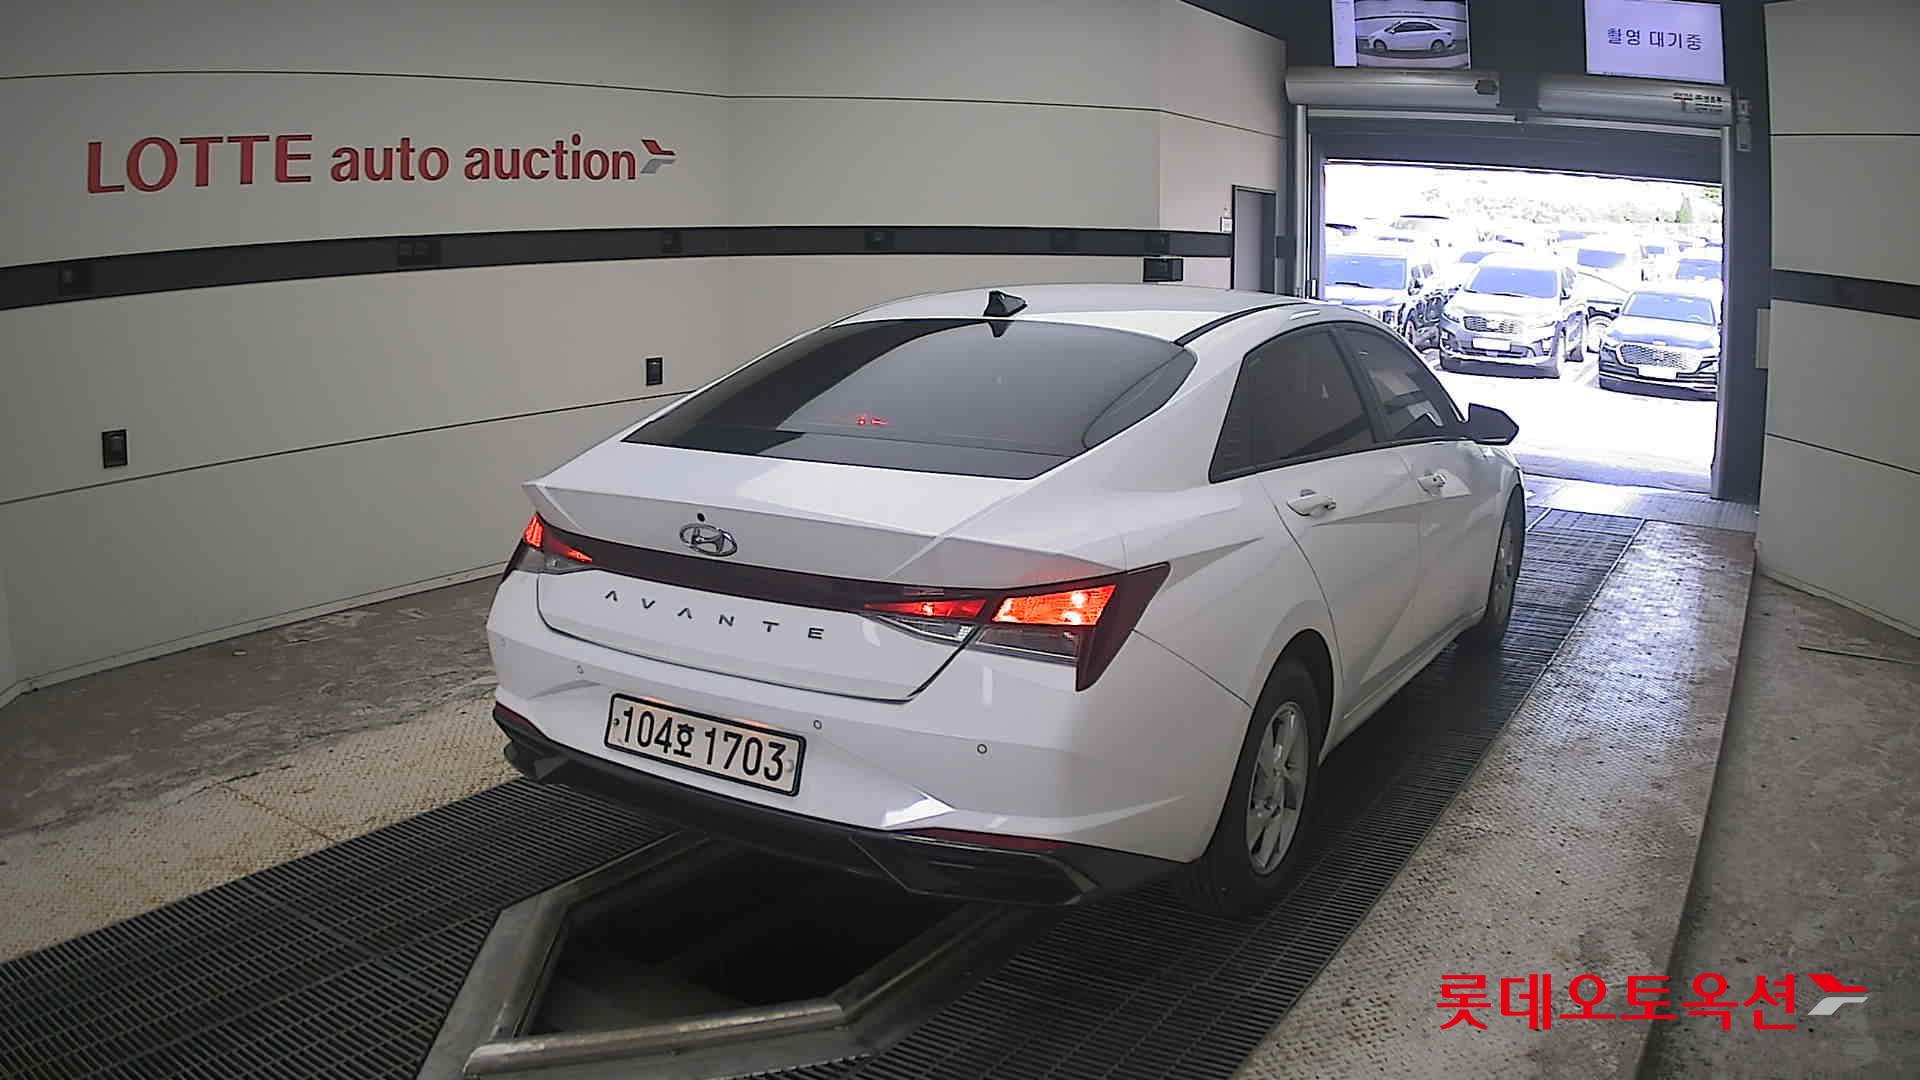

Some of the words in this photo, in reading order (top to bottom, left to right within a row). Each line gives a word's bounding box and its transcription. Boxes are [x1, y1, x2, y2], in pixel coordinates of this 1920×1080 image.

[1607, 27, 1641, 46] 촬영
[1648, 31, 1702, 51] 대기중
[87, 133, 313, 195] LOTTE
[329, 137, 450, 182] auto
[463, 133, 638, 181] auction
[604, 589, 825, 640] AVANTE
[622, 706, 696, 758] 104호
[704, 726, 788, 782] 1703
